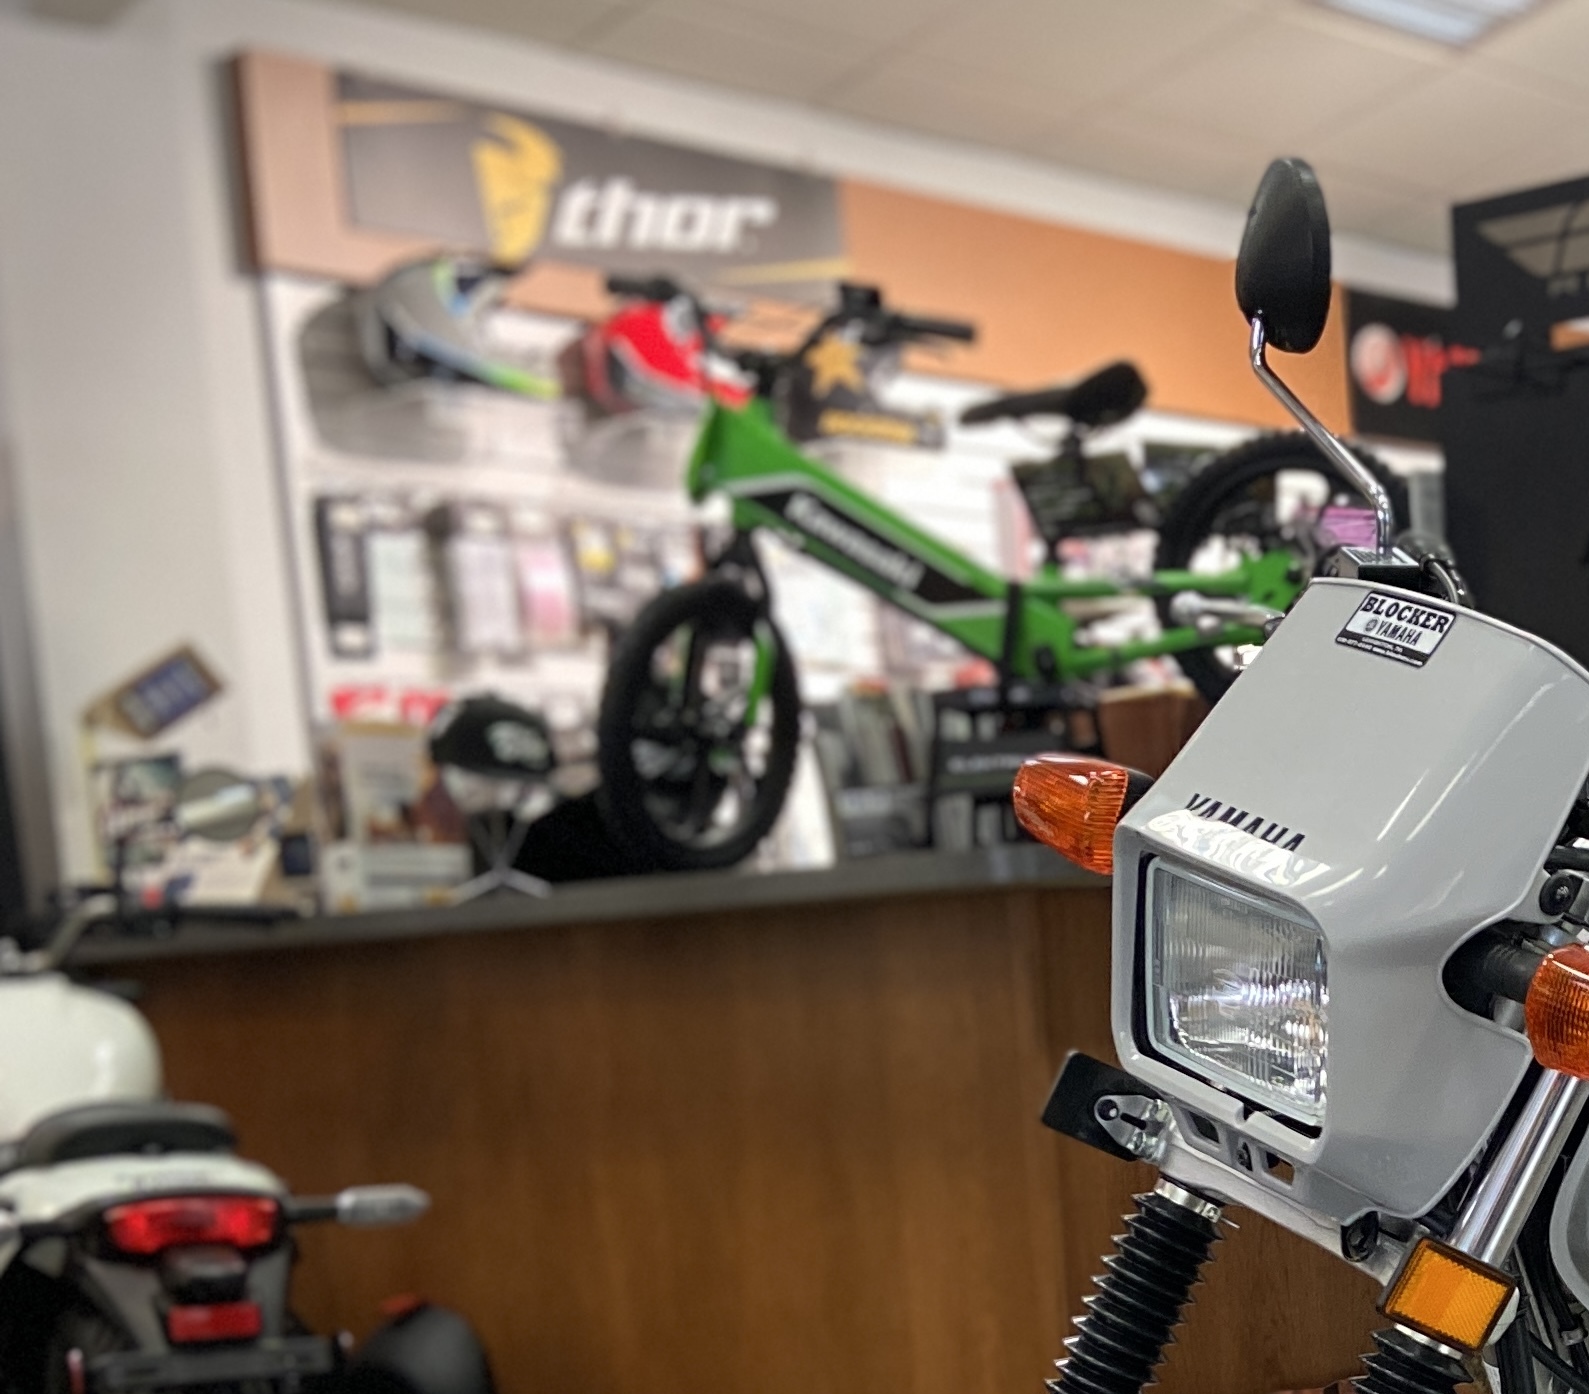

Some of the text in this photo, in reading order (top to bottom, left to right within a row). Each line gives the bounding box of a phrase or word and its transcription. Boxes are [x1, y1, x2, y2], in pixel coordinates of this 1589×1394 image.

[553, 175, 779, 253] thor
[1360, 596, 1450, 634] BLOCKER
[1376, 620, 1423, 647] YAMAHA
